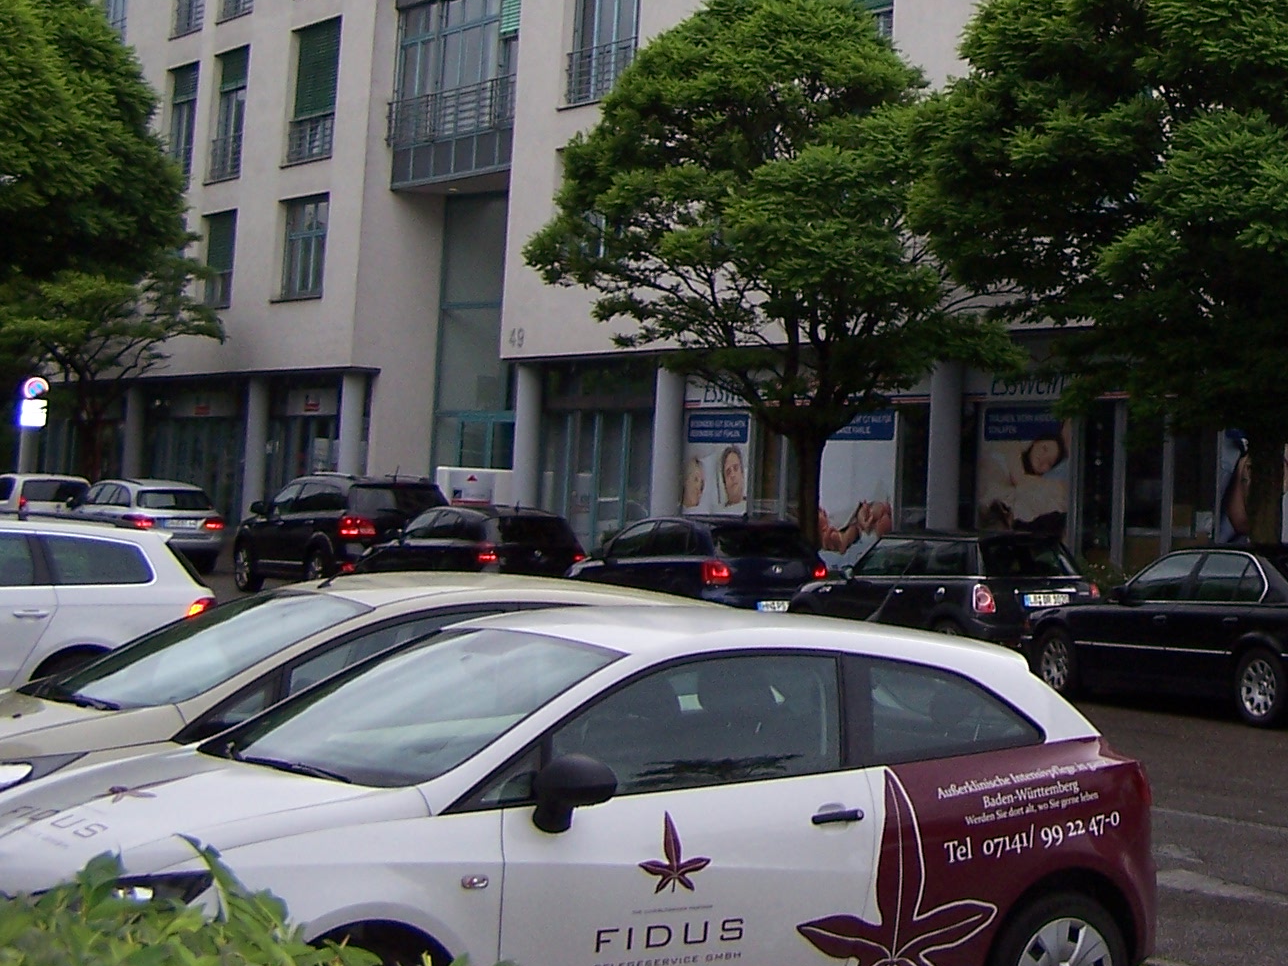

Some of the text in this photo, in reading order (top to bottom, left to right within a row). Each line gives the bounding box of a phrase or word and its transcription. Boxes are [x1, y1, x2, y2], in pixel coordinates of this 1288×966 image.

[509, 328, 525, 348] 49
[938, 776, 1011, 799] Außerklinische
[983, 781, 1079, 808] Baden-Württemberg
[965, 791, 1099, 825] Werden Sie dort alt, wo Sie gerne leben
[944, 811, 1120, 863] Tel 07141/ 99 22 47-0
[595, 918, 744, 953] FIDUS
[705, 952, 742, 962] GMBH
